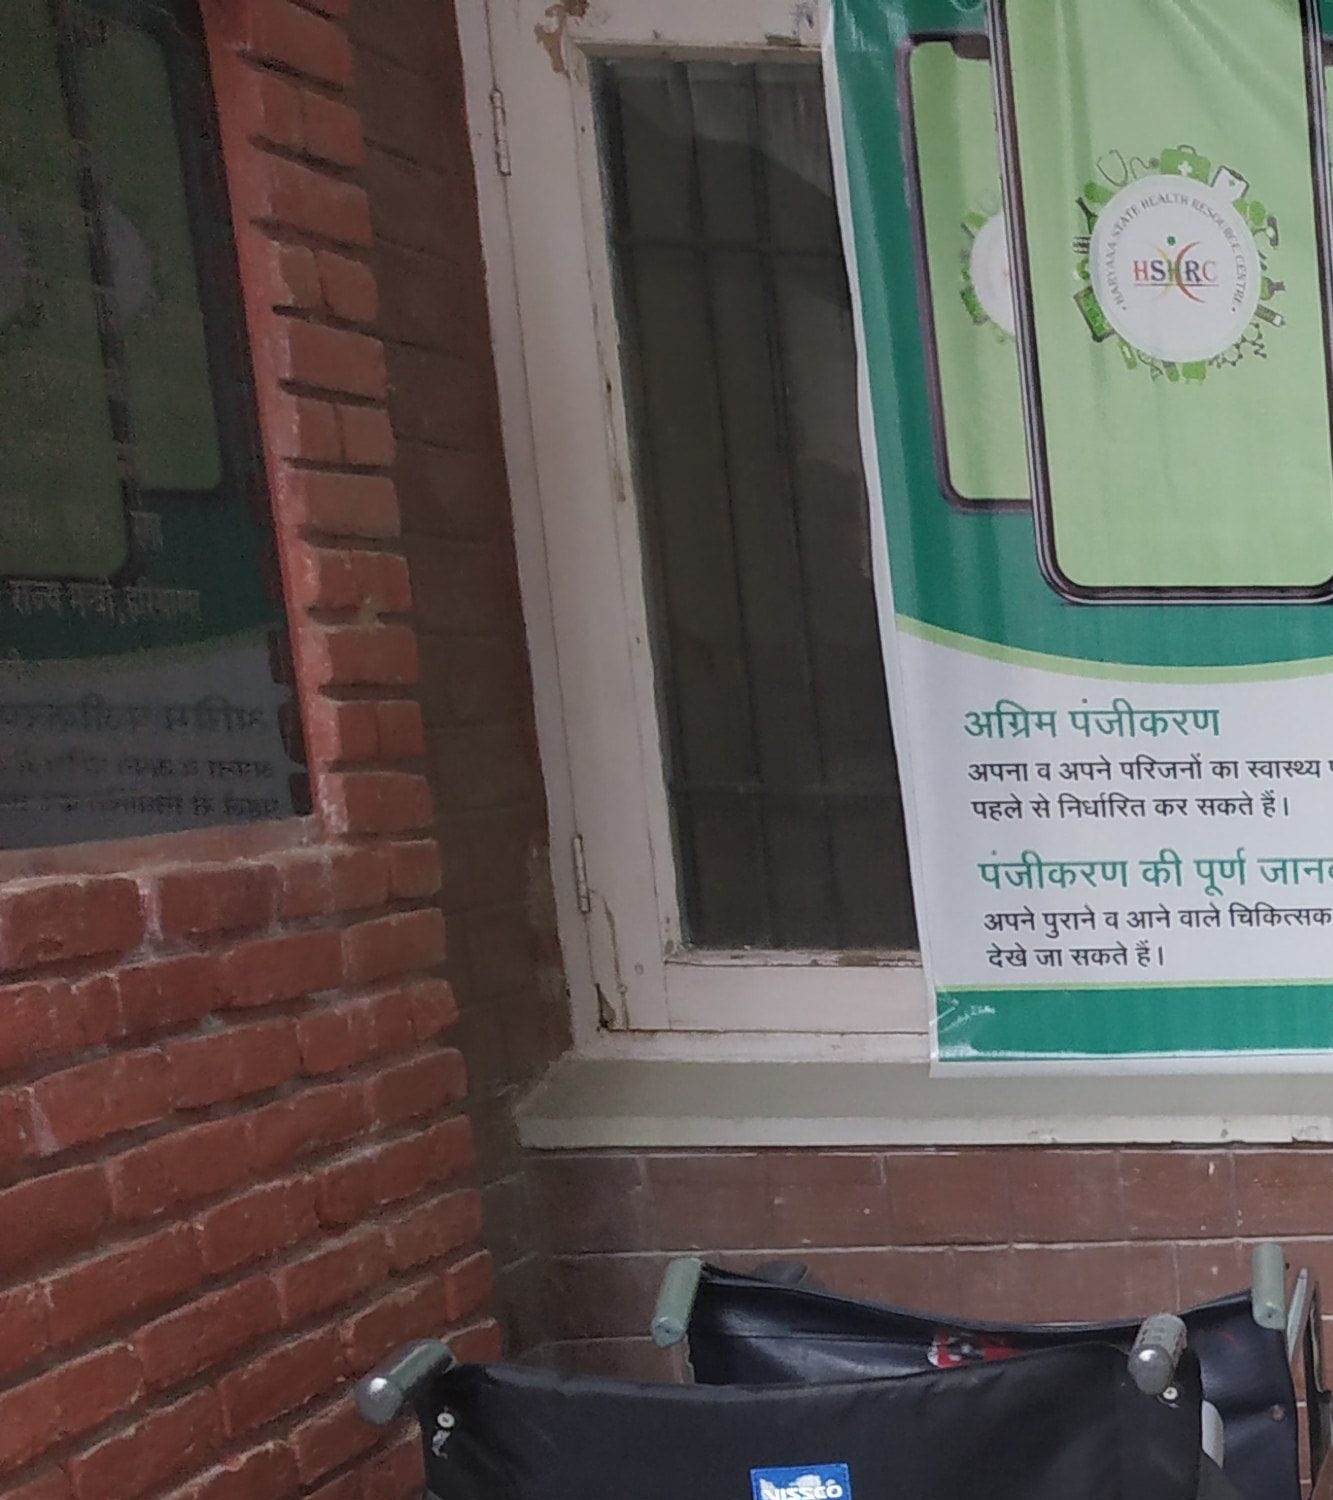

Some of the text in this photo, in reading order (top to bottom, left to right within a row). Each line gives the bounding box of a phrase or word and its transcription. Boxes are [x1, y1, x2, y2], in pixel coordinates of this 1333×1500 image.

[1112, 203, 1142, 236] STATE
[1141, 192, 1189, 210] HEALTH
[964, 698, 1219, 738] अग्रिम पंजीकरण
[968, 763, 1028, 781] अपना
[1035, 763, 1051, 781] व
[1059, 755, 1111, 780] अपने
[1119, 753, 1202, 780] परिजनों
[1209, 761, 1238, 779] का
[1246, 760, 1320, 778] स्वास्थ्य
[971, 791, 1253, 821] पहले से निर्धारित कर सकते
[977, 850, 1127, 889] पंजीकरण
[1139, 849, 1182, 887] की
[1193, 847, 1246, 896] पूर्ण
[984, 906, 1035, 931] अपने
[1042, 905, 1095, 938] पुराने
[1103, 912, 1118, 929] व
[1126, 904, 1170, 929] आने
[1178, 903, 1220, 927] वाले
[1228, 902, 1332, 927] चिकित्सक
[986, 941, 1127, 968] देखे जा सकते
